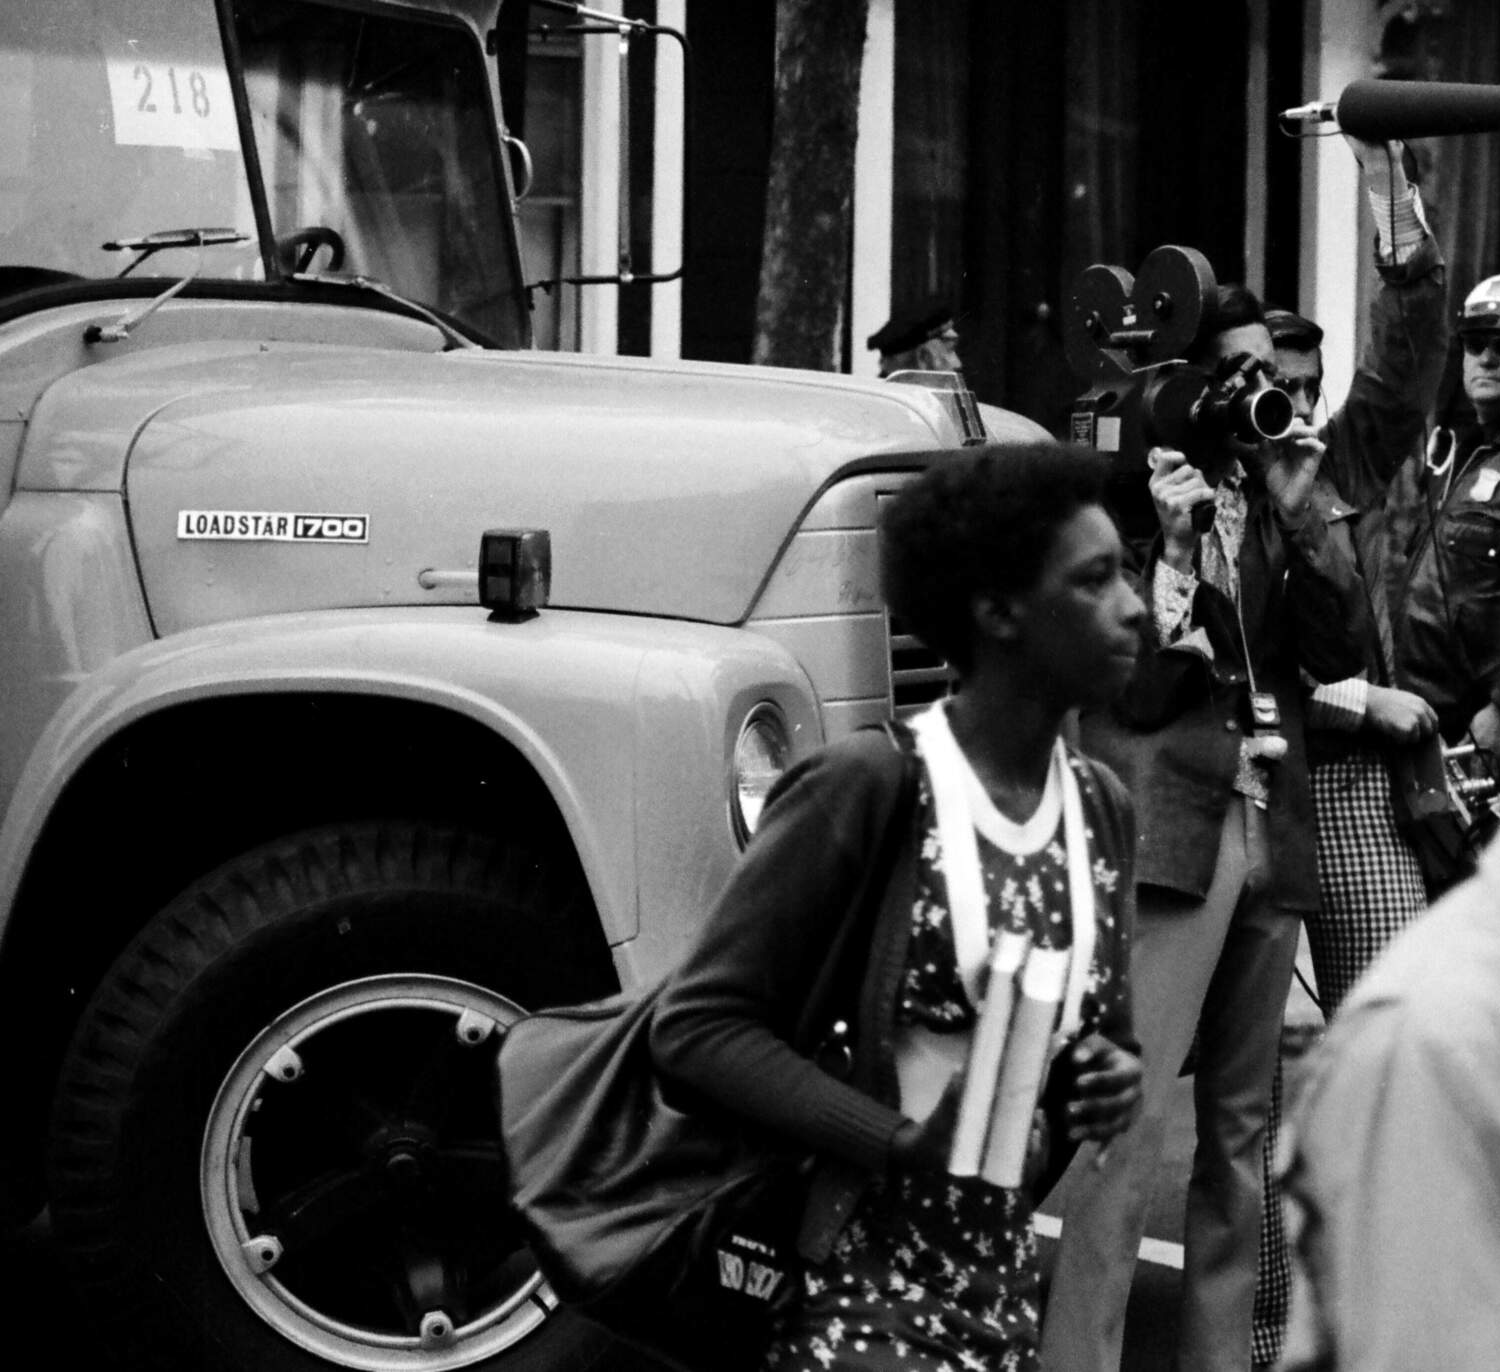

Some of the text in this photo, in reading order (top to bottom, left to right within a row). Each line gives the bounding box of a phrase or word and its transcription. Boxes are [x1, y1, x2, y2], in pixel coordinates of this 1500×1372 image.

[133, 65, 210, 118] 218
[184, 513, 366, 538] LOADSTAR 1700
